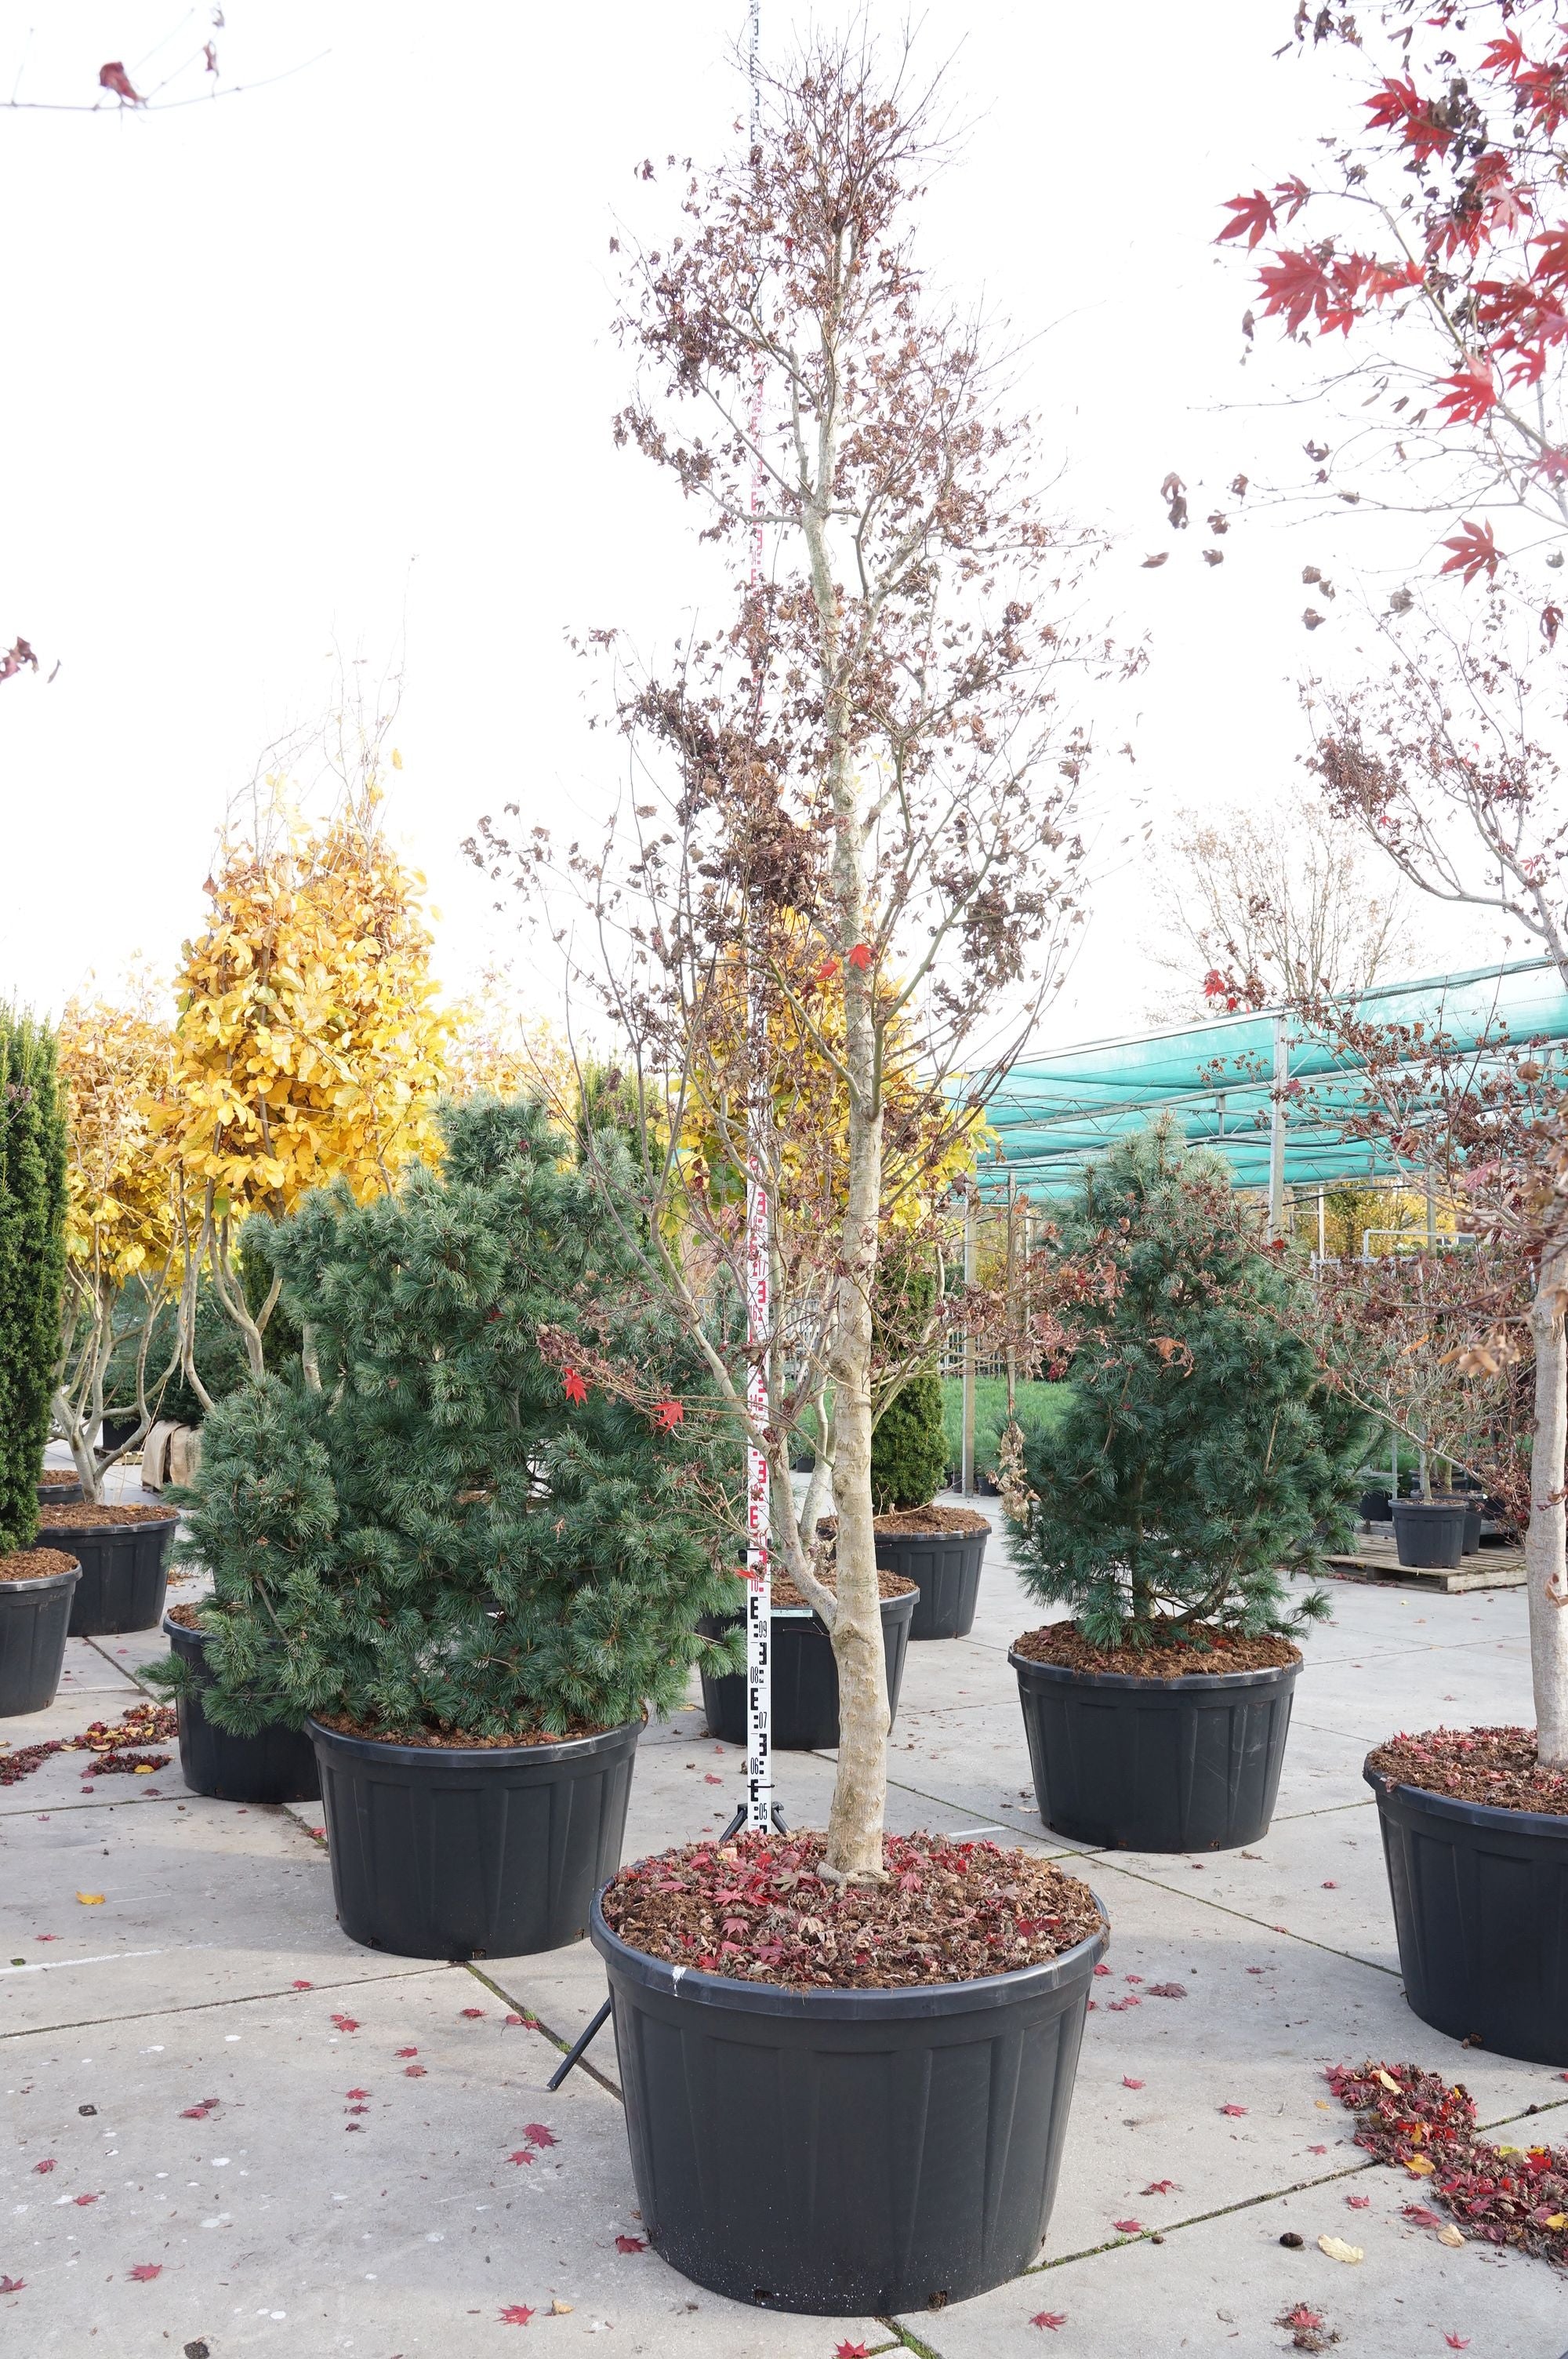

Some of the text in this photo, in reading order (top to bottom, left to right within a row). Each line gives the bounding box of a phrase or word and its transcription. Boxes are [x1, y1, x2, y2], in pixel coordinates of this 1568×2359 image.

[759, 1620, 768, 1638] 09
[750, 1666, 759, 1684] 08
[759, 1711, 768, 1729] 07
[750, 1757, 759, 1775] 06
[759, 1802, 768, 1820] 05
